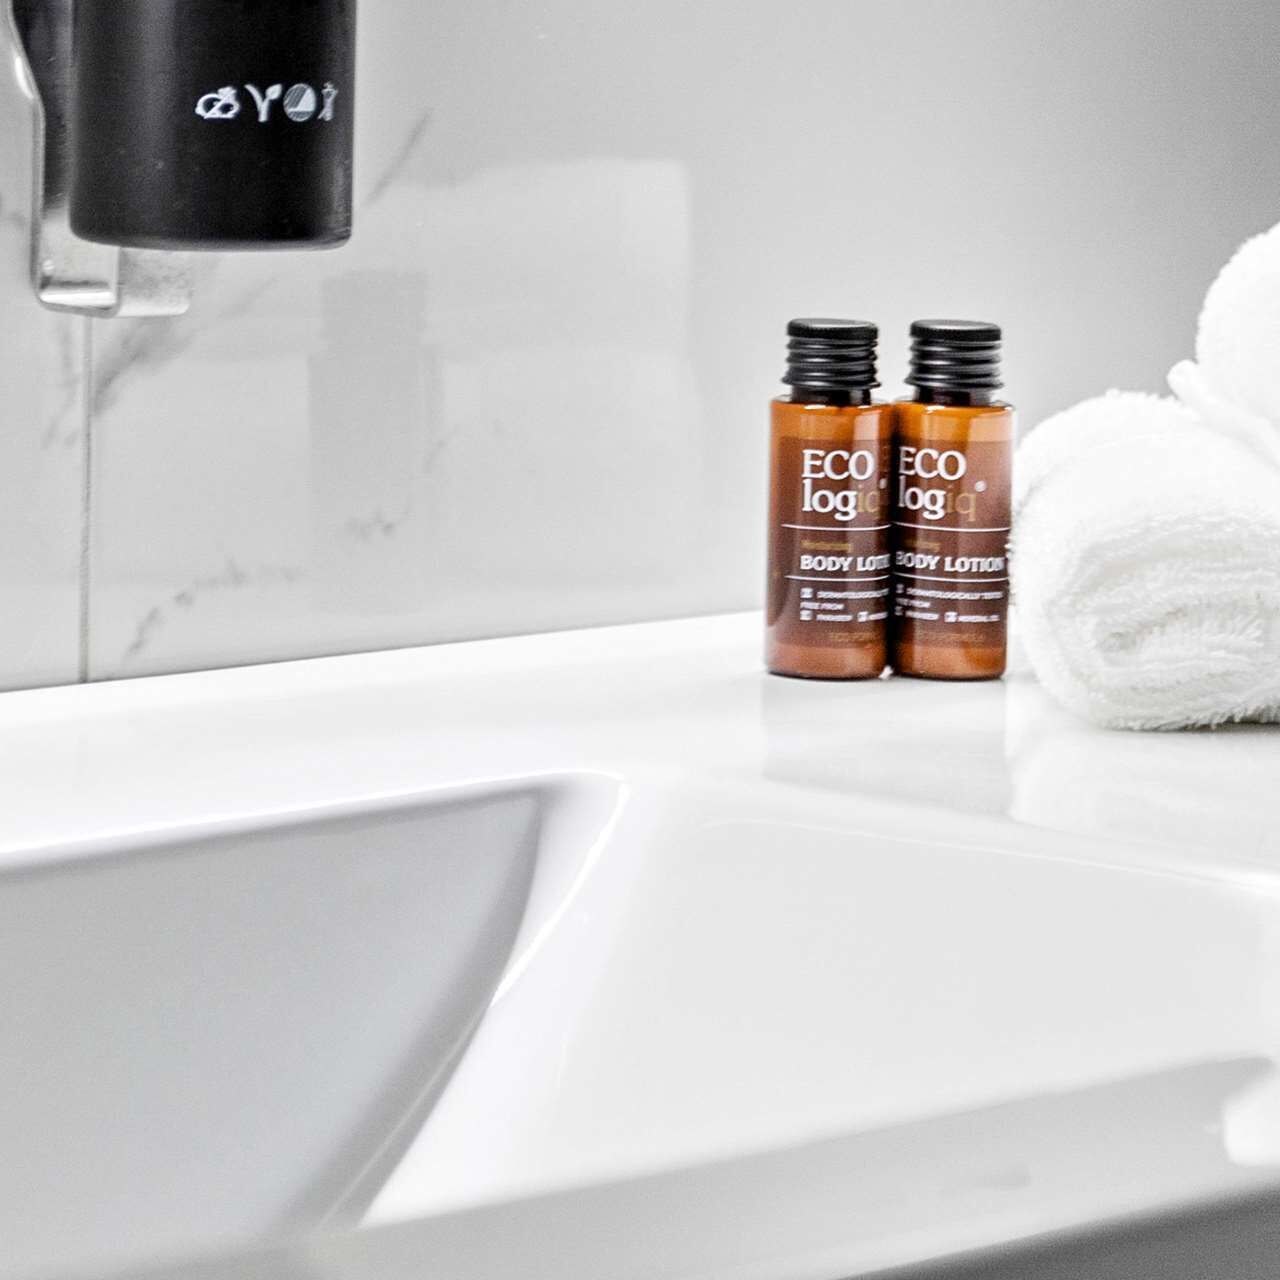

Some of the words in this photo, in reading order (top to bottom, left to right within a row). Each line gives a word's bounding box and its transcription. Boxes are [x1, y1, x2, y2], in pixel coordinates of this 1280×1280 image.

[801, 448, 876, 481] ECO
[898, 445, 967, 481] ECO
[897, 475, 977, 522] logiq
[800, 554, 854, 572] BODY
[896, 550, 941, 571] BODY
